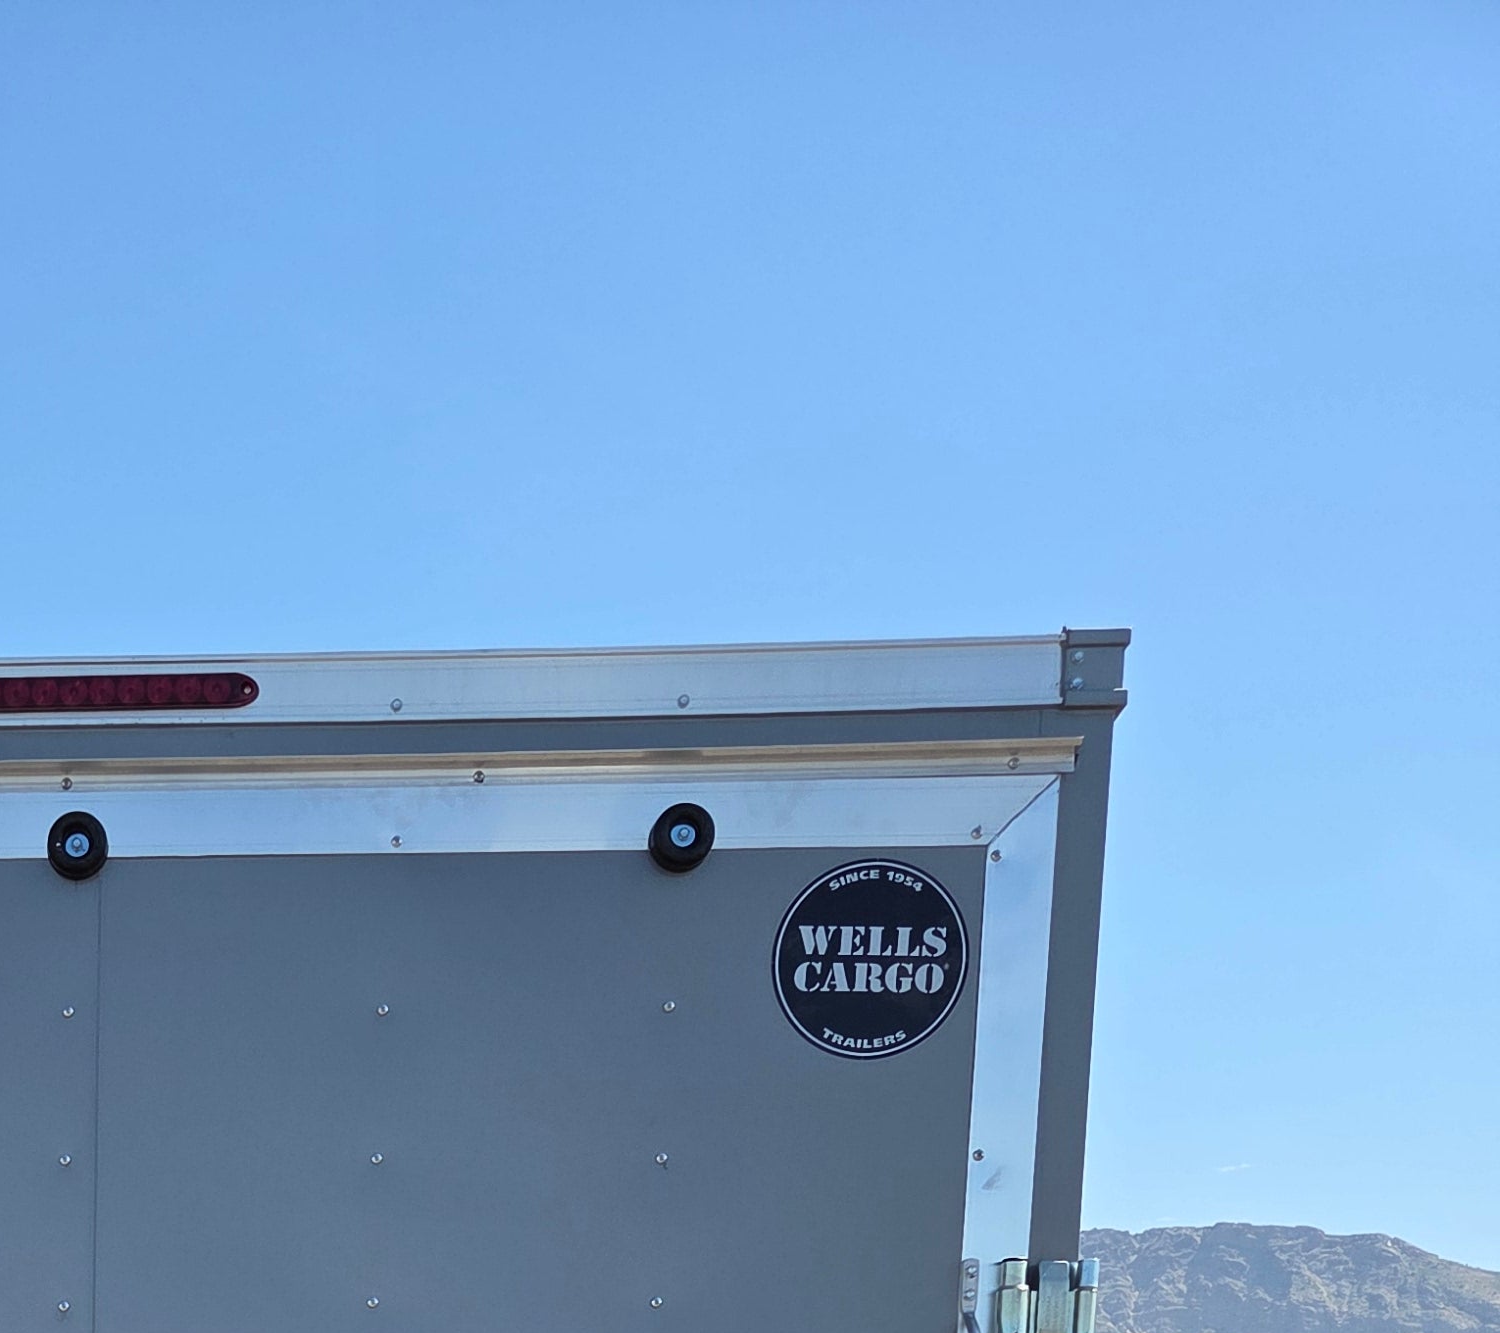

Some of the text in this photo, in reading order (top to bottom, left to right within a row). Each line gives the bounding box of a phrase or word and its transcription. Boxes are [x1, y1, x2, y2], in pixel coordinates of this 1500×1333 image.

[829, 870, 924, 892] SINCE 1954
[798, 925, 948, 958] WELLS
[793, 961, 945, 994] CARGO
[822, 1027, 907, 1049] TRAILERS
